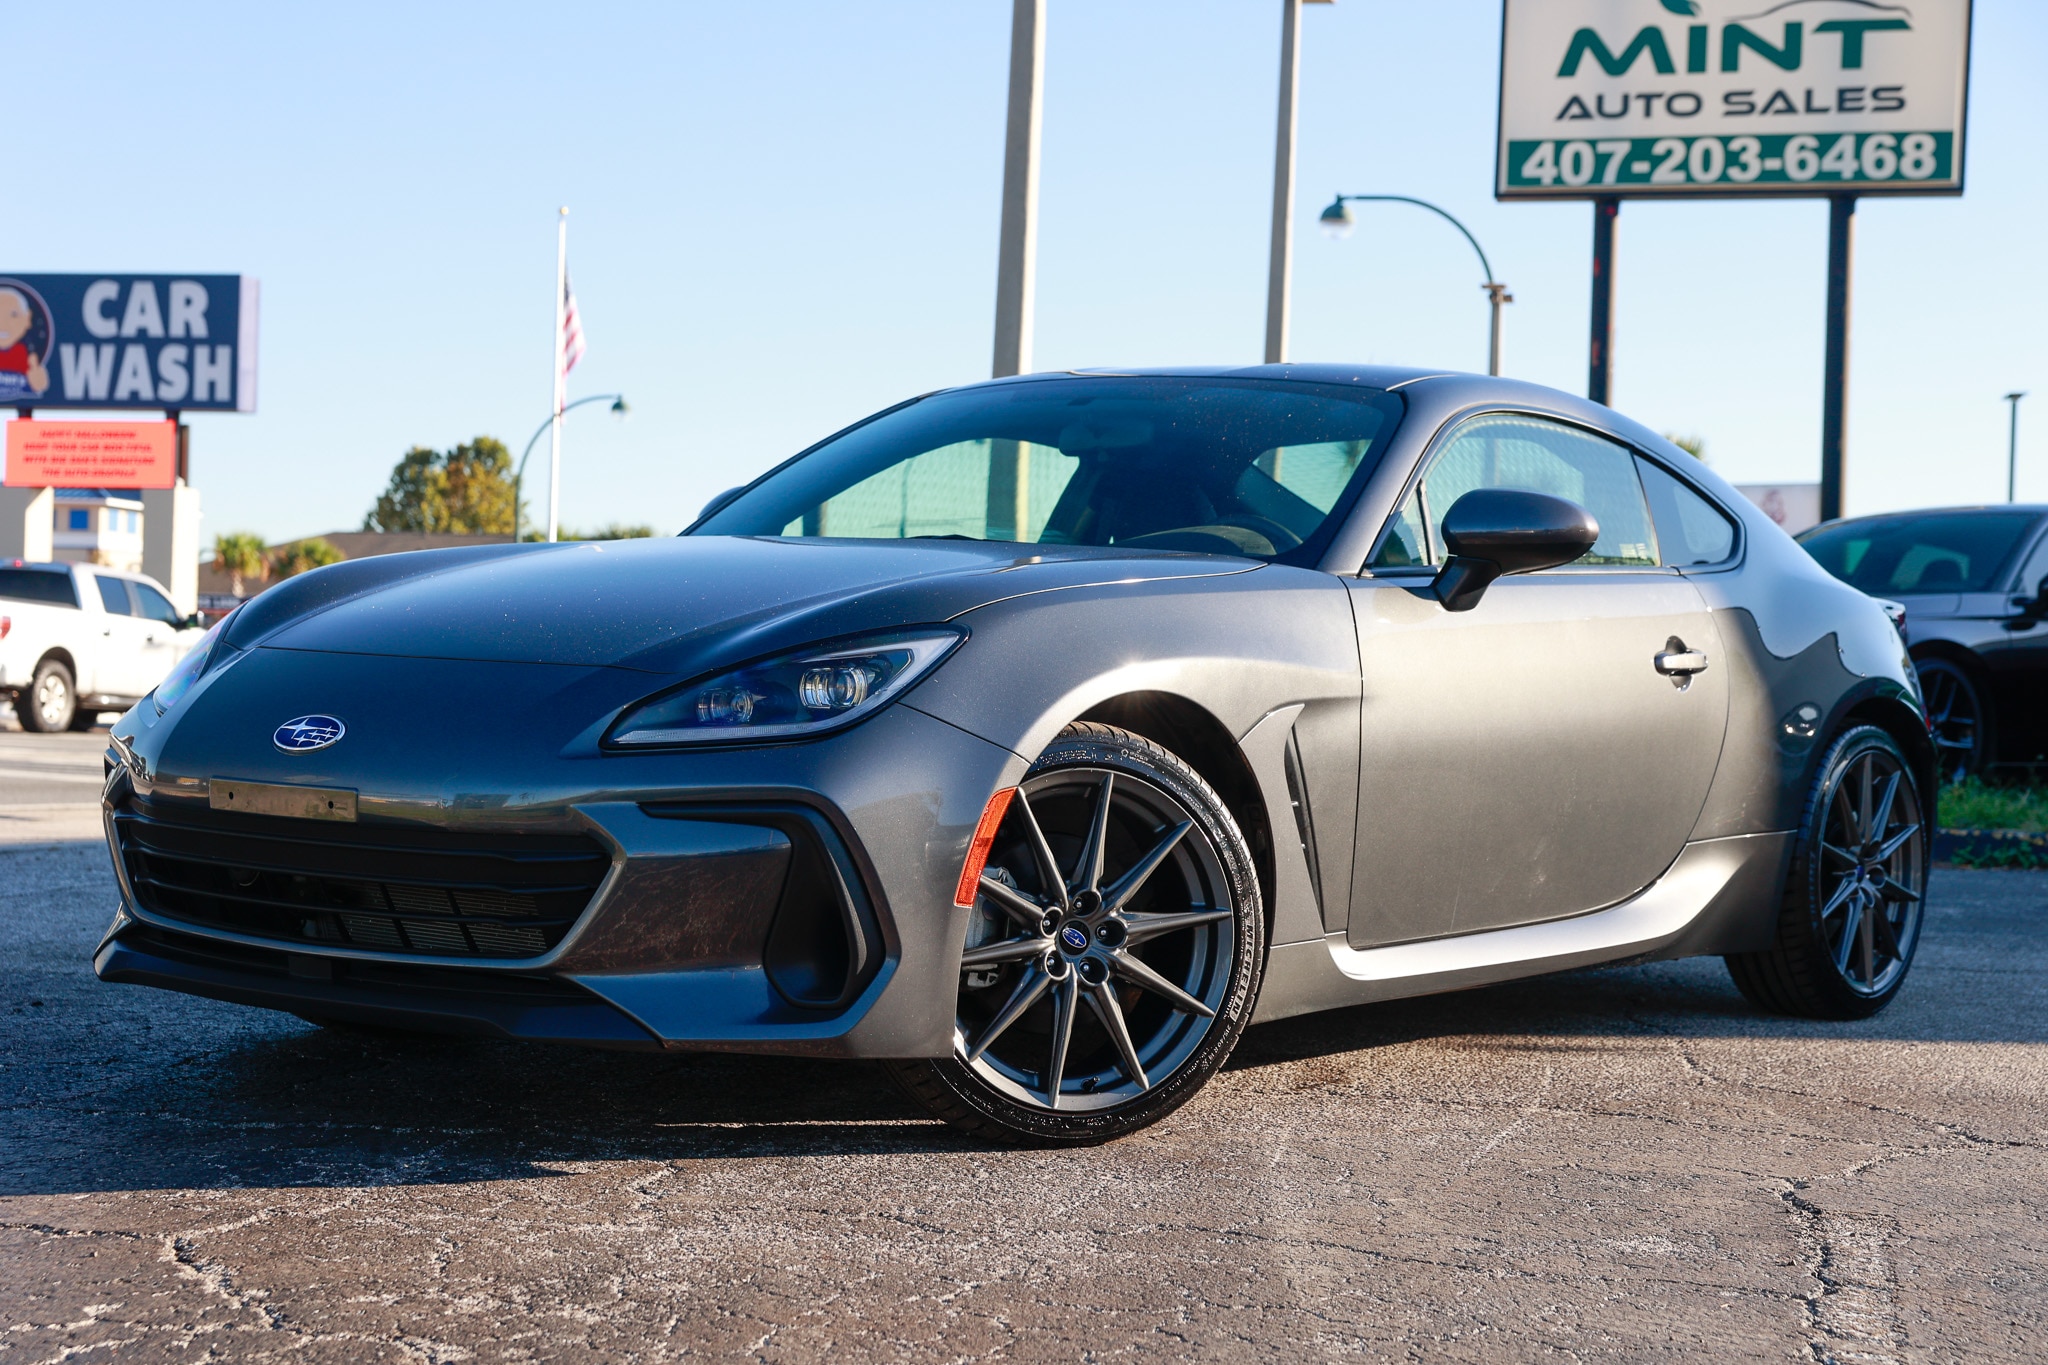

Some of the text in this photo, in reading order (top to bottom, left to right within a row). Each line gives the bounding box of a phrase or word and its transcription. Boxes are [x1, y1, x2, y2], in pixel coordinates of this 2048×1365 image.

[1555, 18, 1913, 78] MINT
[1556, 86, 1907, 121] AUTO SALES
[1520, 133, 1938, 187] 407-203-6468
[82, 279, 210, 339] CAR
[59, 344, 233, 401] WASH
[1231, 923, 1255, 1019] MICHELIN
